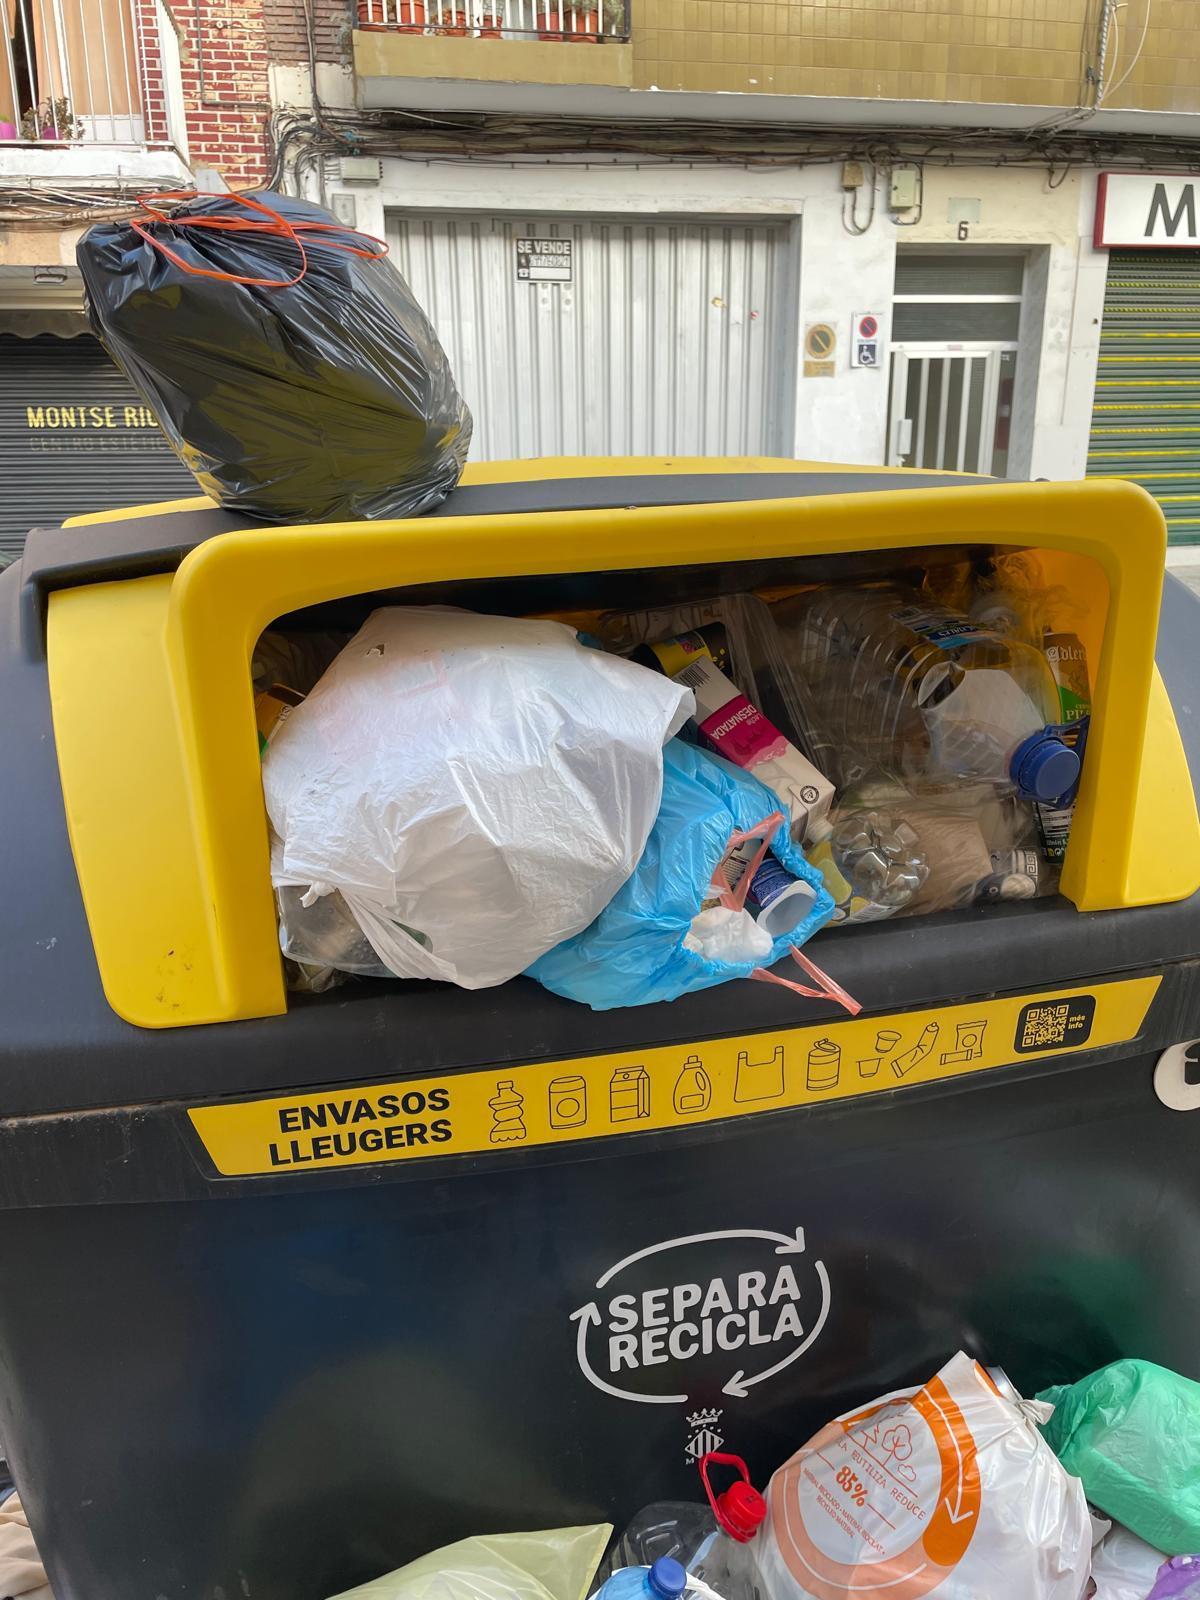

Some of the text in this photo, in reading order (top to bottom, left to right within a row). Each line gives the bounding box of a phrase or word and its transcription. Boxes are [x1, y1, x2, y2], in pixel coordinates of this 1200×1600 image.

[517, 240, 571, 254] SE VENDE
[958, 220, 969, 241] 6
[27, 407, 117, 428] MONTSE
[709, 703, 757, 740] DESNATADA
[1068, 1022, 1083, 1030] info
[279, 1088, 450, 1133] ENVASOS
[269, 1119, 453, 1166] LLEUGERS
[608, 1264, 801, 1333] SEPARA
[608, 1303, 804, 1372] RECICLA
[835, 1464, 869, 1508] 85%
[889, 1486, 927, 1521] REDUCE
